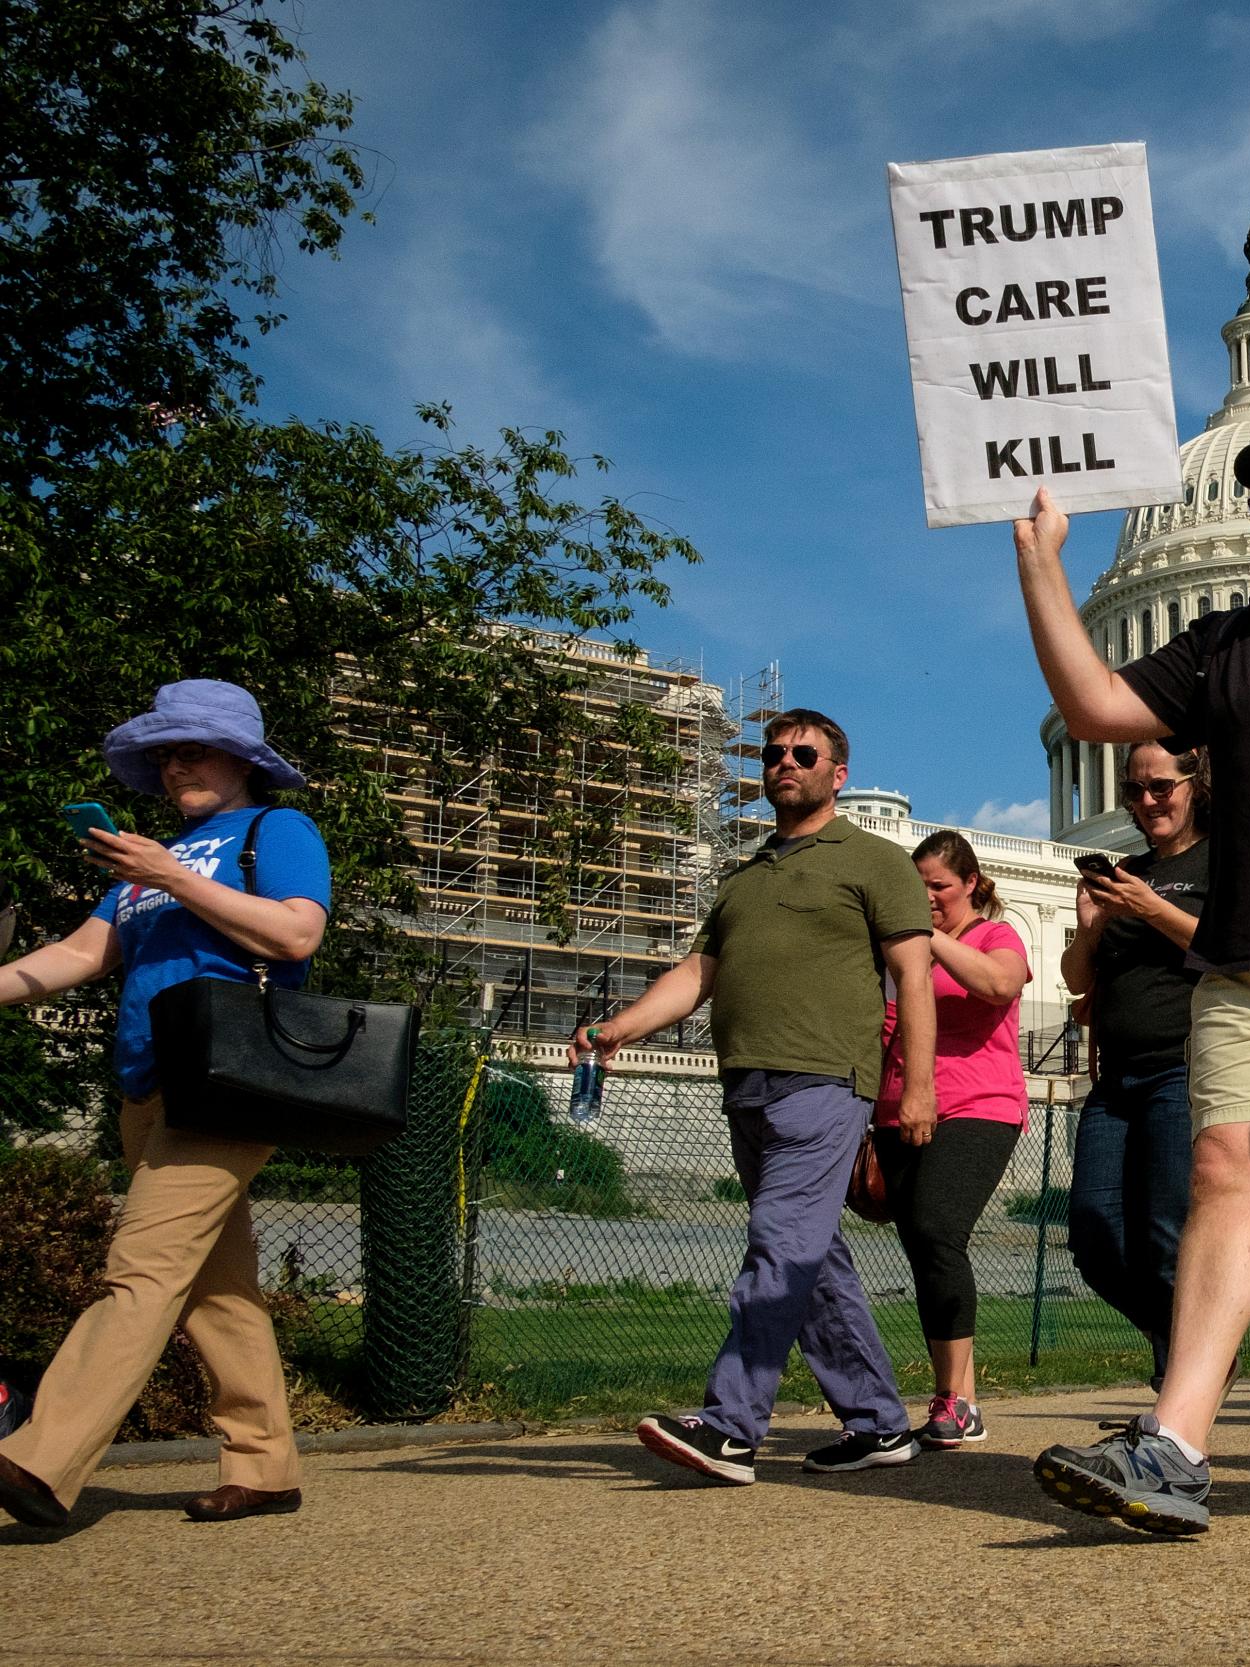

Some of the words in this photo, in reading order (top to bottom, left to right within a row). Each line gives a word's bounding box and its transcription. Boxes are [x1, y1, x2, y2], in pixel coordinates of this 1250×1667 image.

[920, 196, 1124, 249] TRUMP
[955, 276, 1111, 326] CARE
[968, 353, 1112, 401] WILL
[986, 432, 1116, 479] KILL
